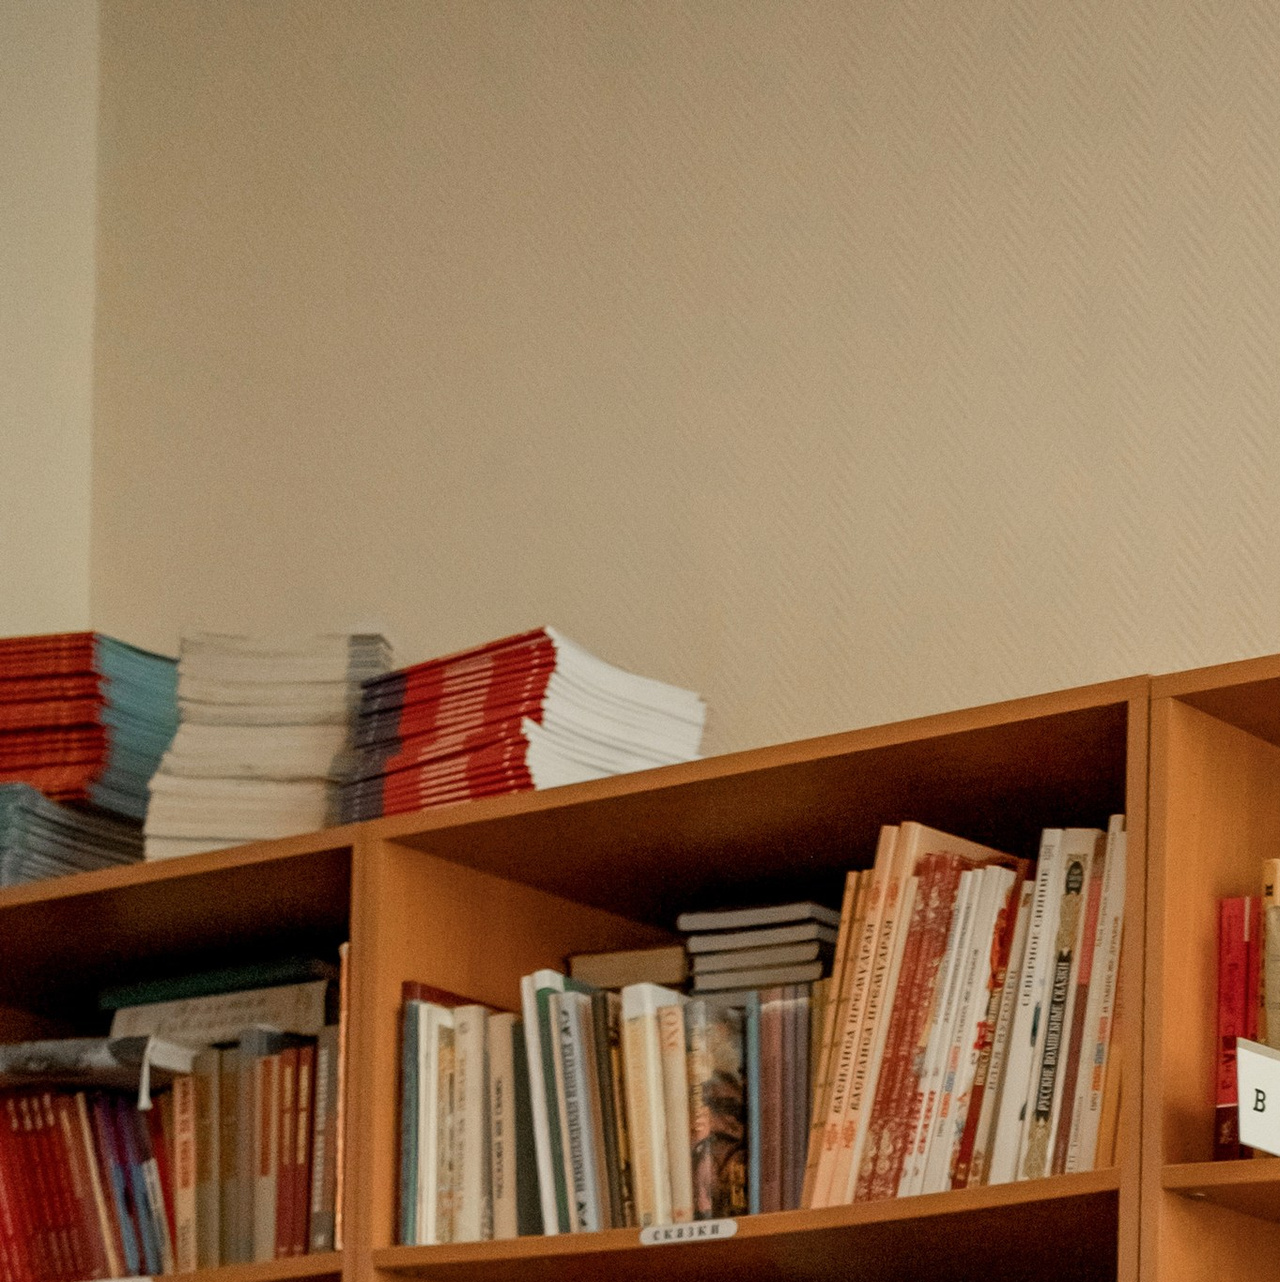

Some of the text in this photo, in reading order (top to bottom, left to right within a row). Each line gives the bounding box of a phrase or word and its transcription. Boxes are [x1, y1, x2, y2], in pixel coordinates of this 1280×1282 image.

[832, 922, 875, 1114] ВАСИЛИСА ПРЕМУДРАЯ
[850, 919, 893, 1110] ВАСИЛИСА ПРЕМУДРАЯ
[987, 1050, 1002, 1089] ИЛЬЯ
[995, 969, 1018, 1044] МУРОМЕЦ
[1021, 933, 1039, 1007] СЕВЕРНОЕ
[1035, 960, 1070, 1112] РУССКИЕ ВОЛШЕБНЫЕ СКАЗКИ
[1253, 1088, 1265, 1112] В
[652, 1224, 719, 1240] сказки
